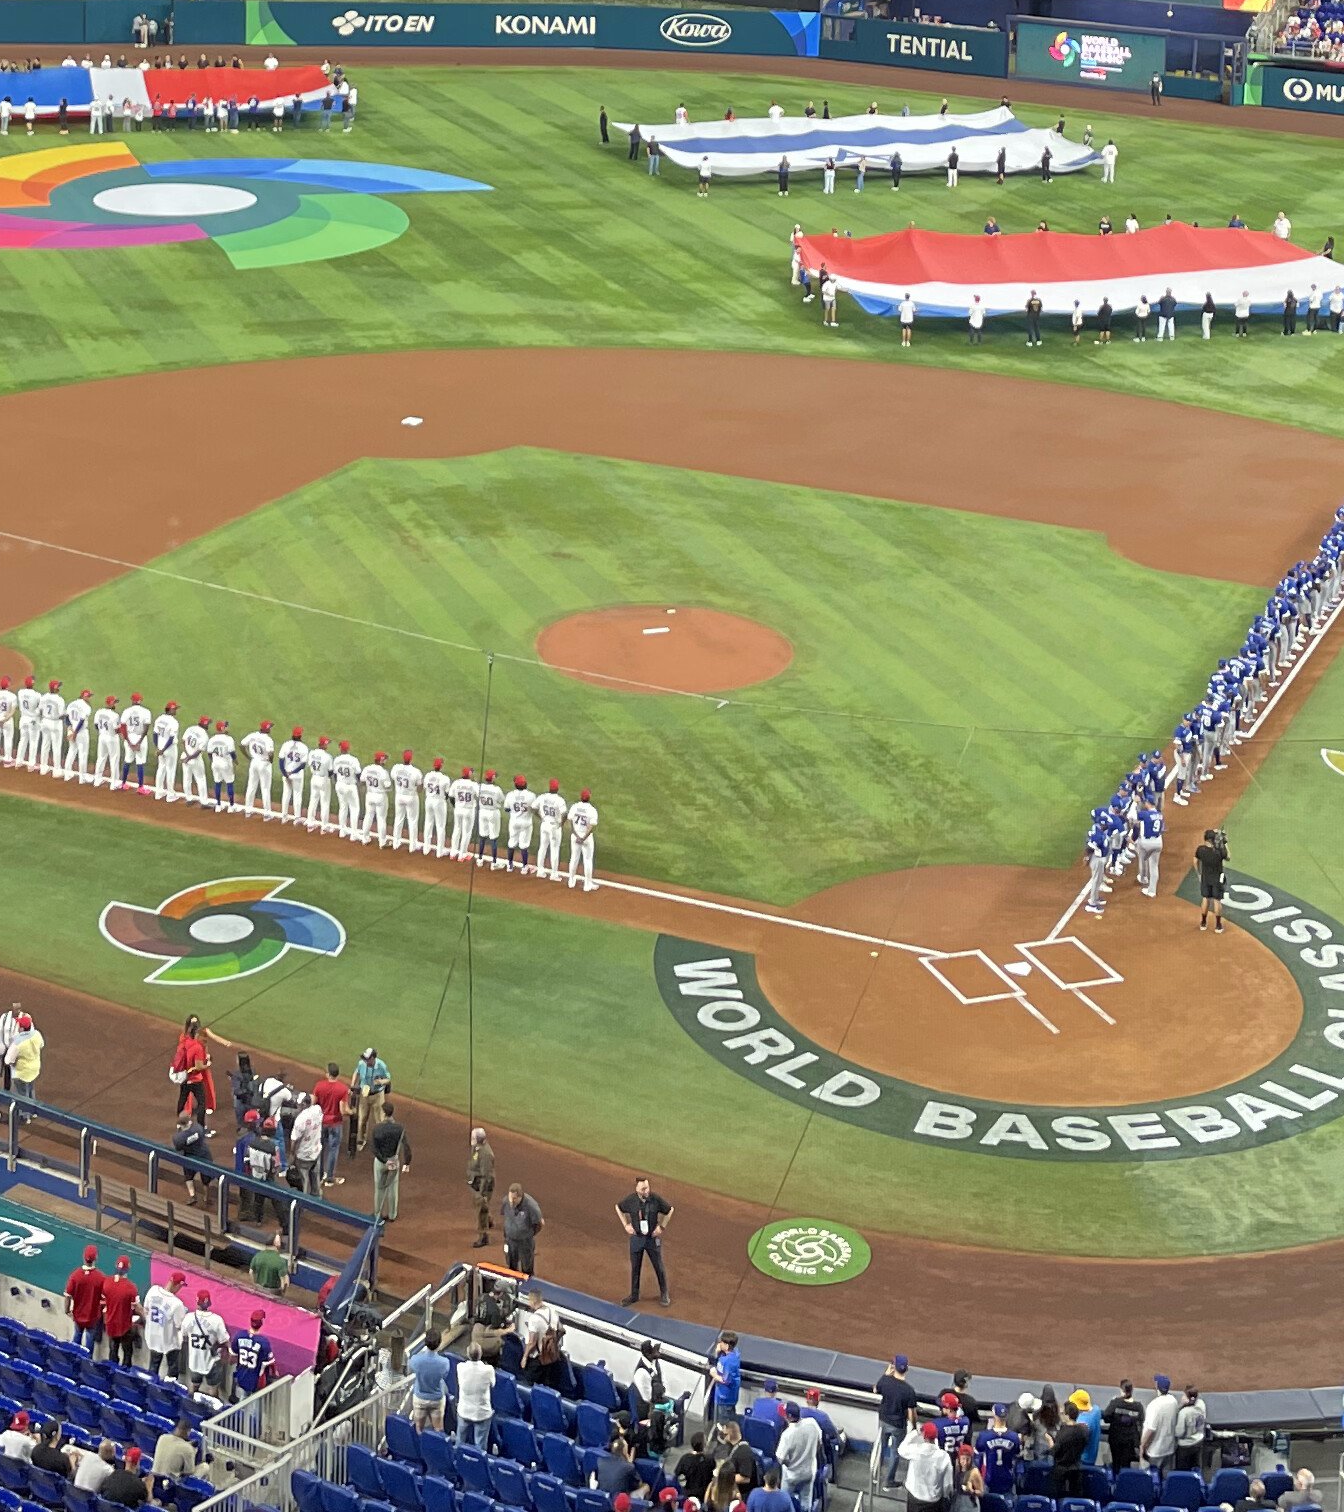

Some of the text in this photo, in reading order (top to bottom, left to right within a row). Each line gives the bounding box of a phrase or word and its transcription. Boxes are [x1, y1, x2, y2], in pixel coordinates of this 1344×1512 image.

[495, 15, 596, 35] KONAMI
[666, 16, 729, 40] Kowa
[887, 33, 973, 61] TENTIAL
[1081, 35, 1119, 47] WORLD
[573, 814, 588, 826] 75
[673, 957, 882, 1108] WORLD
[238, 1346, 258, 1368] 23
